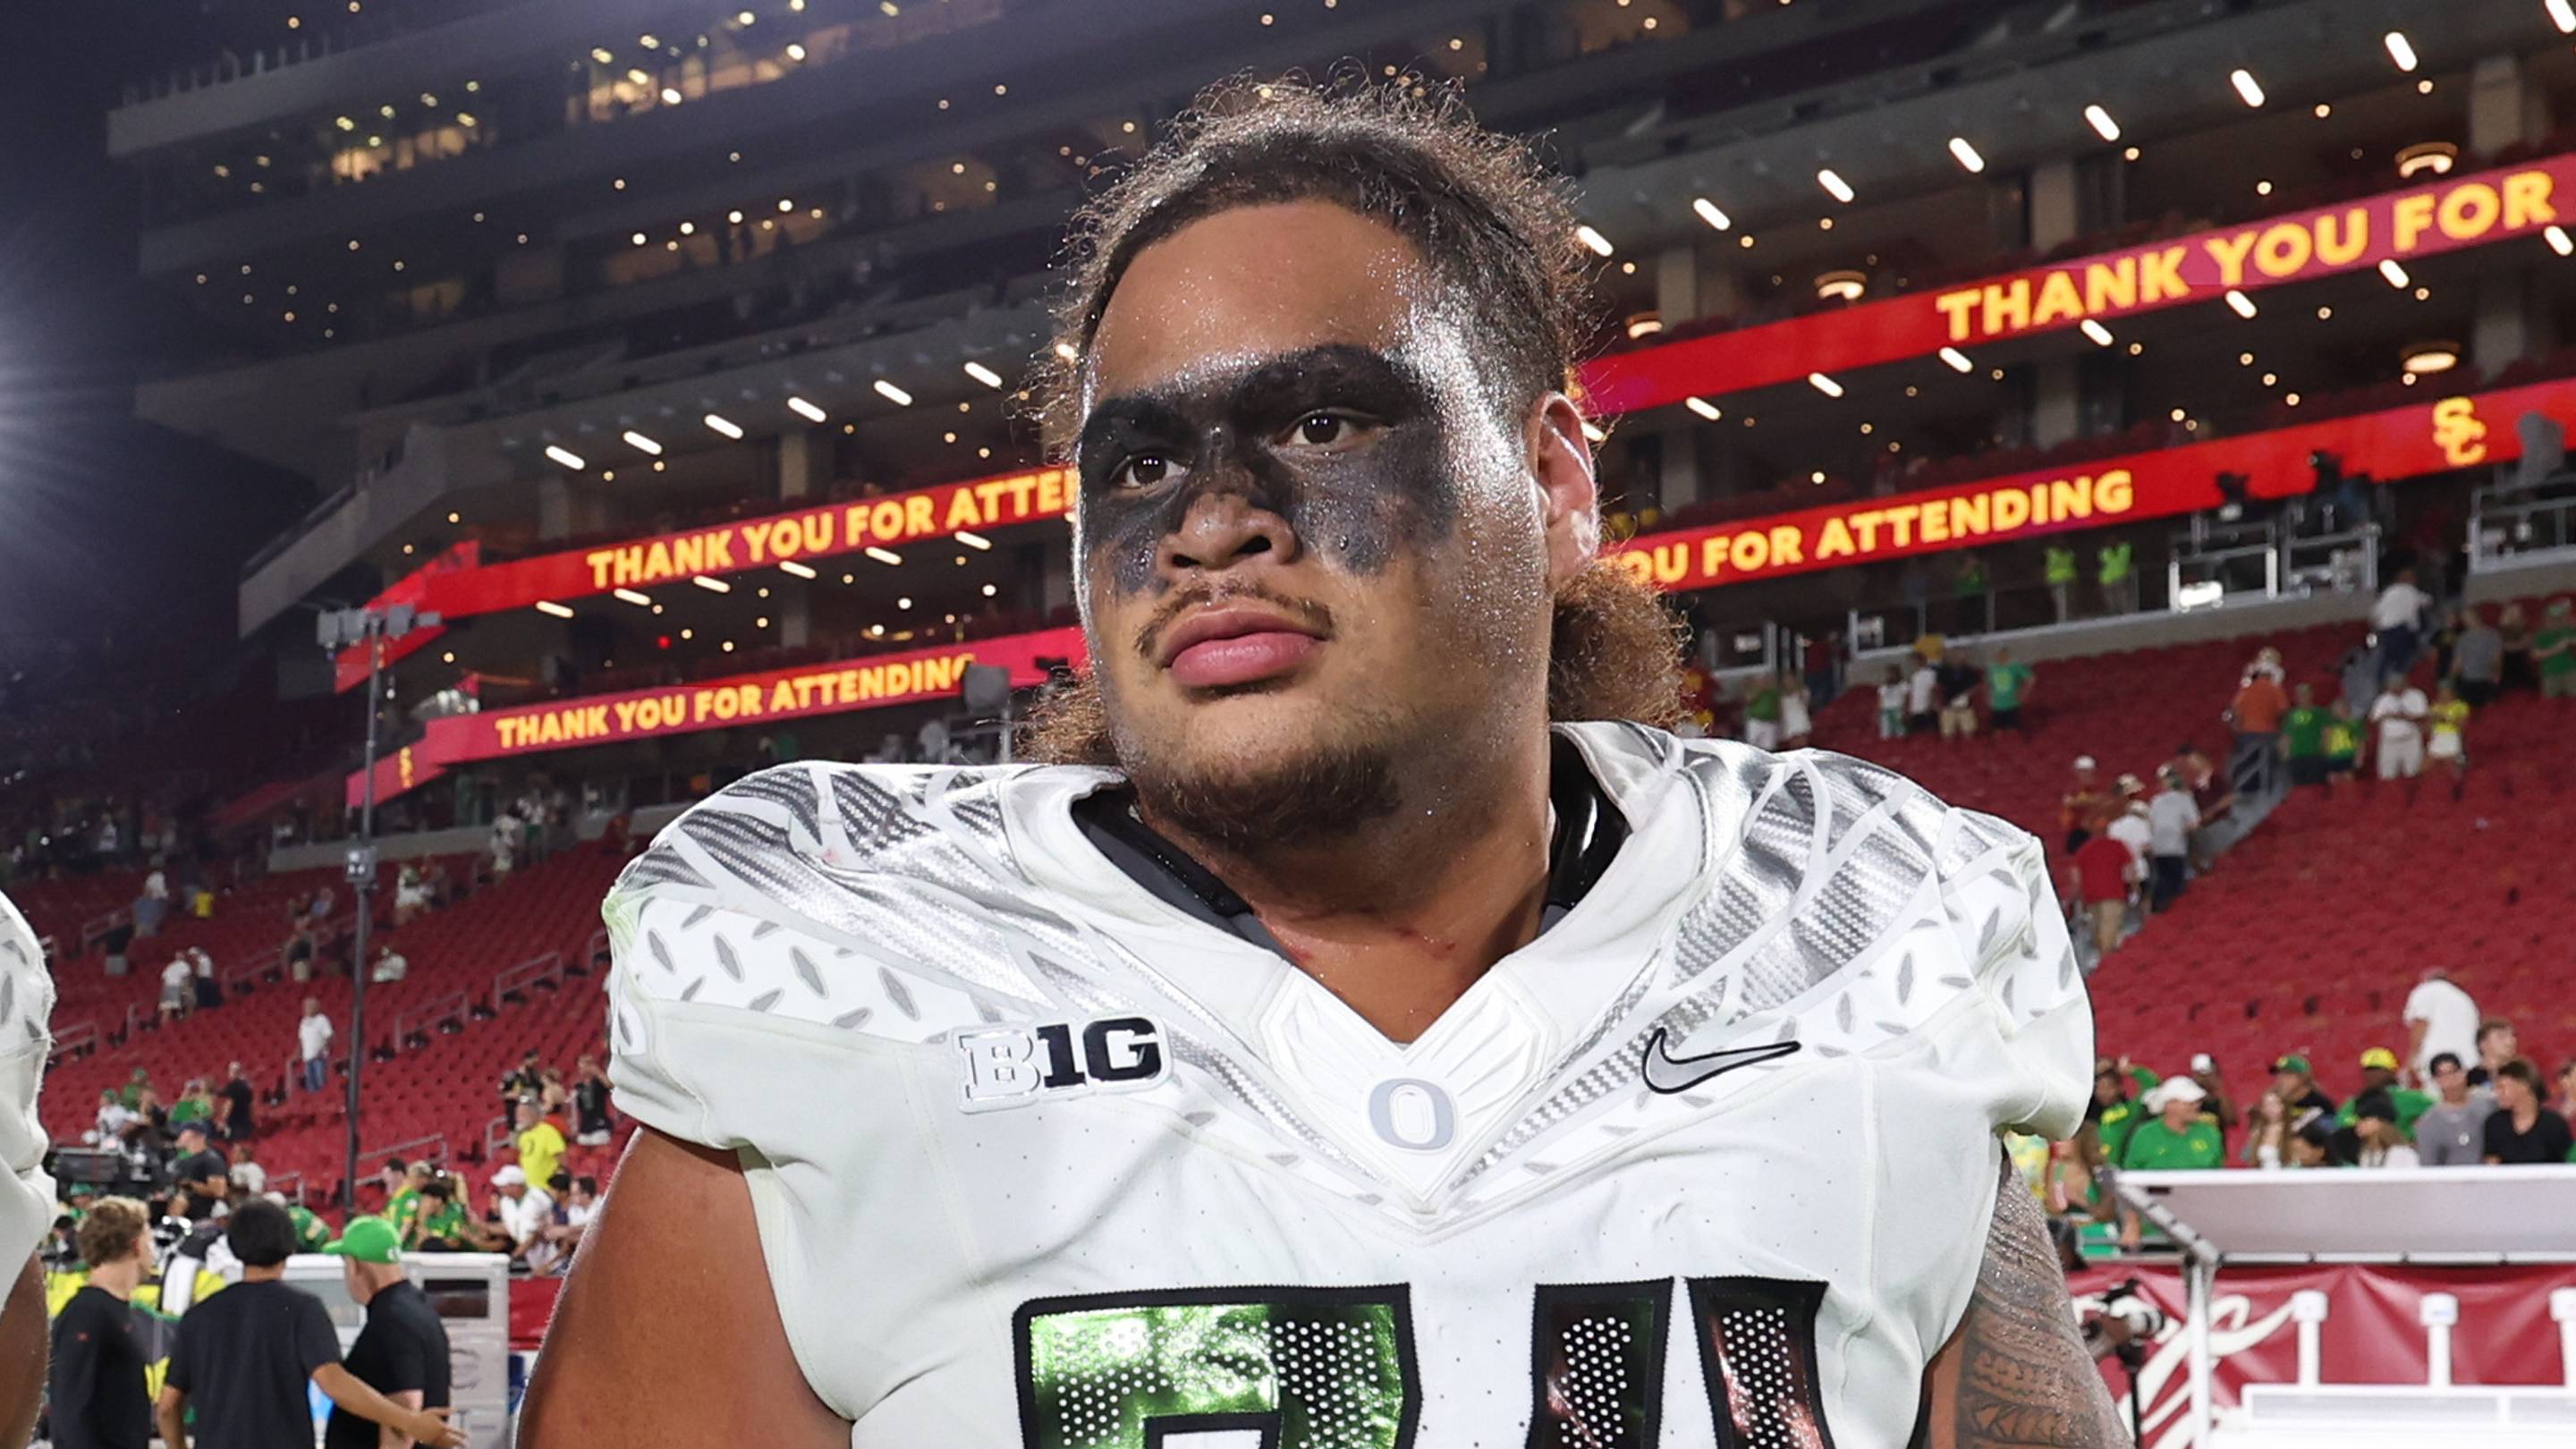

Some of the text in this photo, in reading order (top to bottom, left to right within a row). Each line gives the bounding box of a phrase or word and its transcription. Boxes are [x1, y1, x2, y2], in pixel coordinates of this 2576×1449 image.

[1936, 171, 2556, 340] THANK YOU FOR
[587, 530, 733, 588] THANK
[741, 512, 834, 563] YOU
[846, 496, 935, 546] FOR
[1613, 470, 2132, 586] OU FOR ATTENDING
[495, 705, 609, 748] THANK
[614, 695, 686, 731] YOU
[694, 684, 763, 722] FOR
[1368, 1078, 1455, 1151] O
